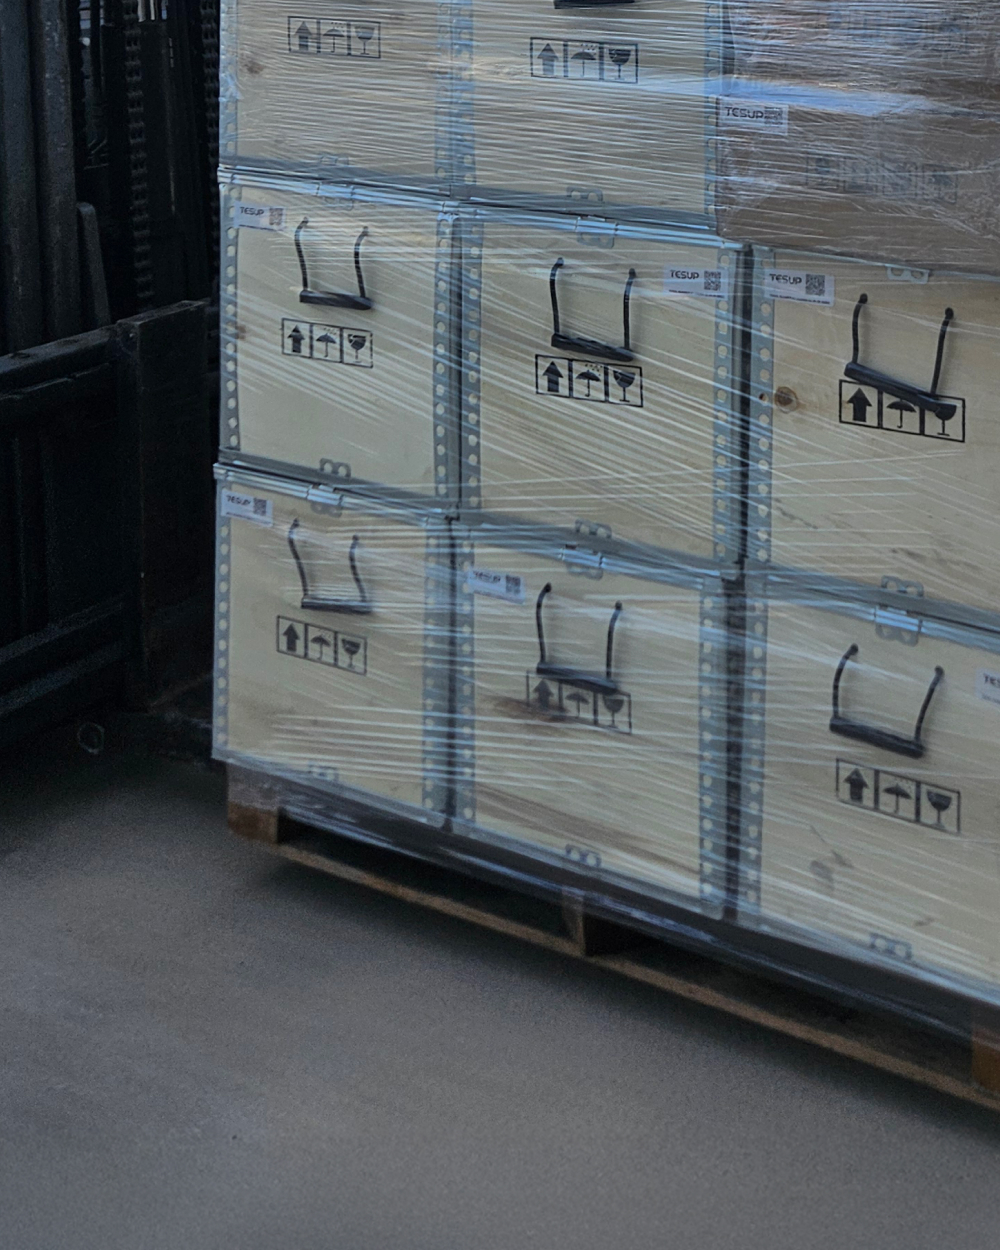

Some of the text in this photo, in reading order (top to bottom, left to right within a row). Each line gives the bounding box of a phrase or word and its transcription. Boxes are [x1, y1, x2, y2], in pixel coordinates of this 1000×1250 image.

[724, 106, 764, 119] TESUP
[669, 269, 700, 280] TESUP
[769, 273, 802, 285] TESUP
